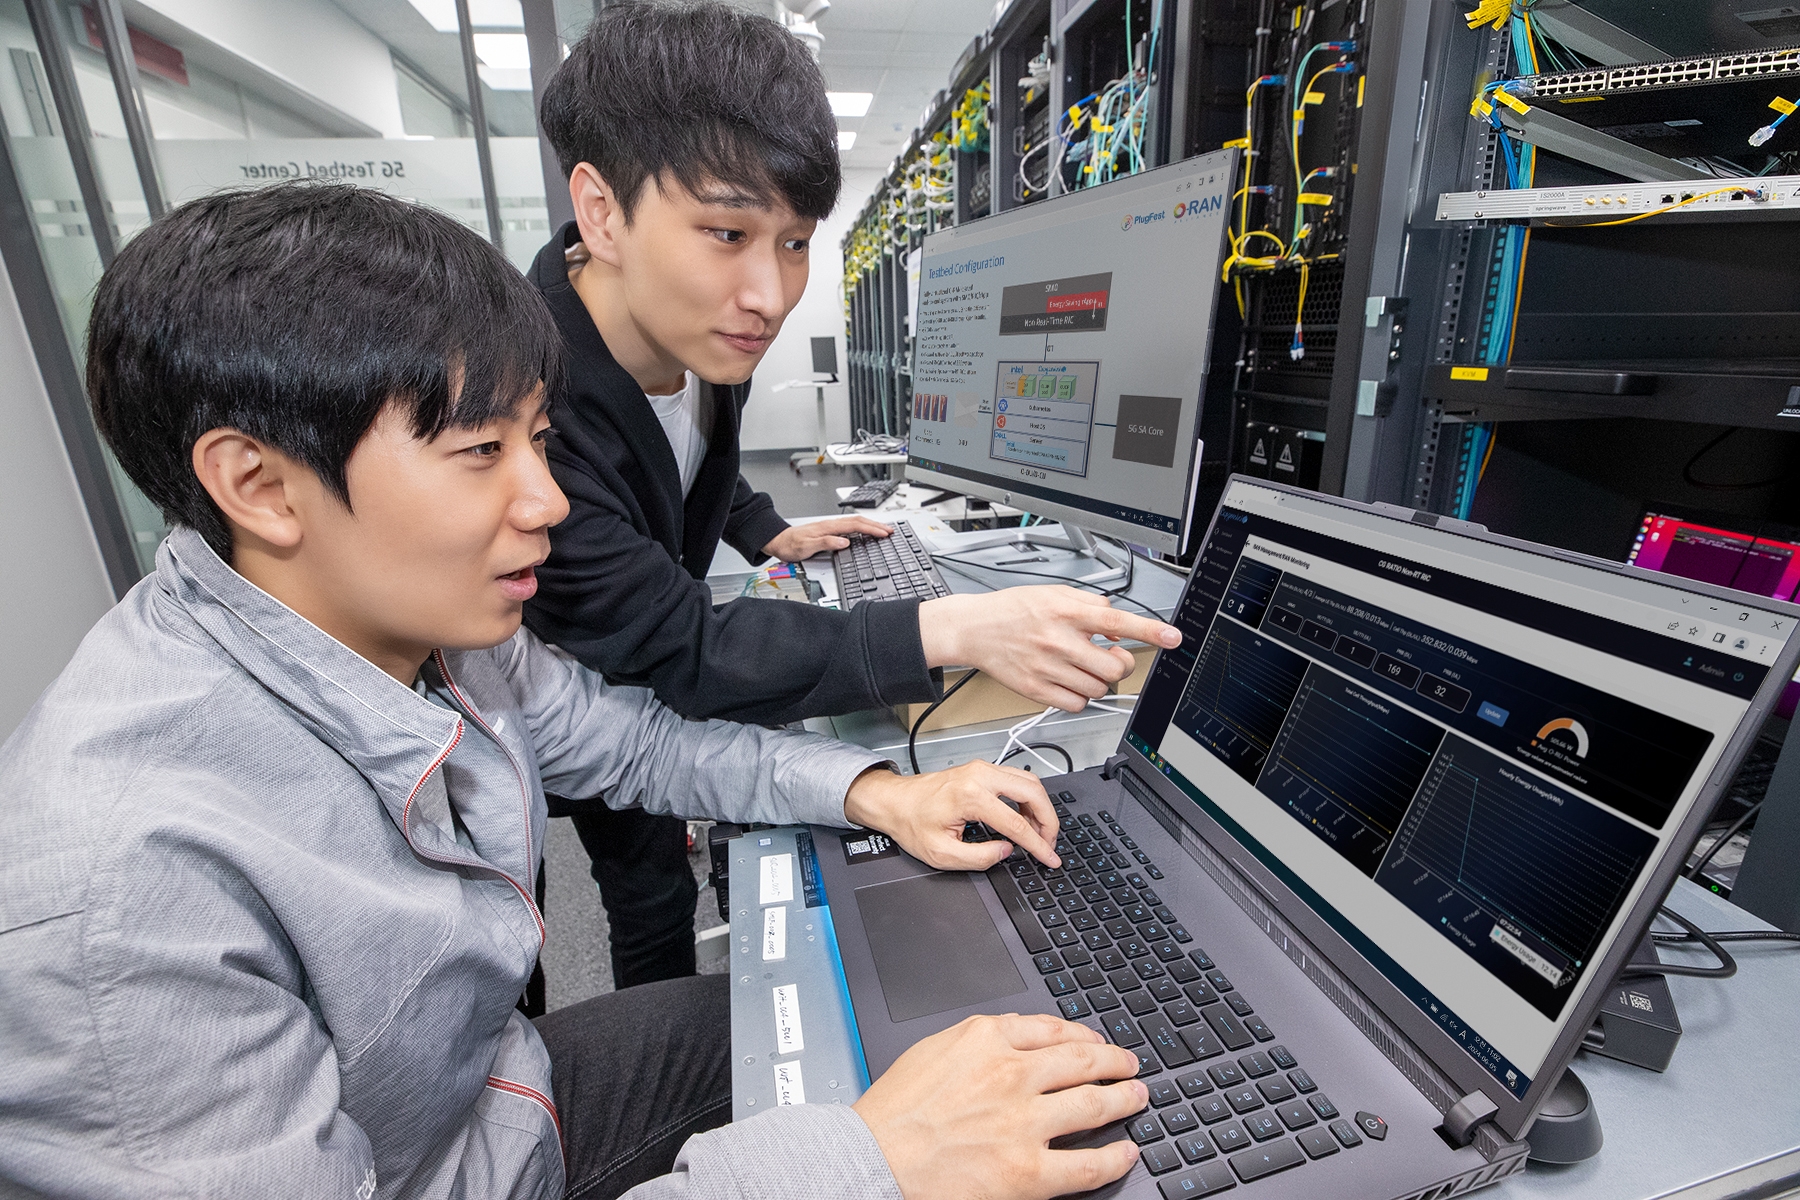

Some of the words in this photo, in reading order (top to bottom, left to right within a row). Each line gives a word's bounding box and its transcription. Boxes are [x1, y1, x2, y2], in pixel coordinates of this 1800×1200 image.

[1173, 194, 1223, 219] O-RAN
[1133, 210, 1166, 225] PlugFest
[928, 263, 954, 280] Testbed
[954, 255, 1005, 275] Configuration
[1128, 424, 1138, 434] 5G
[1138, 425, 1147, 435] SA
[1148, 426, 1164, 437] Core
[1280, 615, 1287, 623] 4
[1313, 629, 1319, 638] 1
[1350, 646, 1356, 655] 1
[1420, 634, 1468, 659] 352.832/0.039
[1387, 663, 1401, 676] 169
[1698, 663, 1725, 678] Admin
[1434, 685, 1447, 698] 32
[1484, 707, 1501, 720] Update
[1537, 743, 1548, 753] Avg
[1563, 755, 1580, 767] Power
[1498, 767, 1515, 781] Hourly
[1514, 775, 1532, 790] Energy
[1446, 922, 1462, 937] Energy
[1461, 932, 1477, 948] Usage
[1500, 934, 1519, 952] Energy
[1518, 947, 1537, 964] Usage
[1540, 962, 1558, 979] 12.14
[1159, 1027, 1177, 1048] ENTER
[1458, 1030, 1467, 1040] A
[1474, 1036, 1487, 1050] 오전
[1467, 1043, 1497, 1072] 2024-06-05
[1486, 1047, 1501, 1062] 11:02
